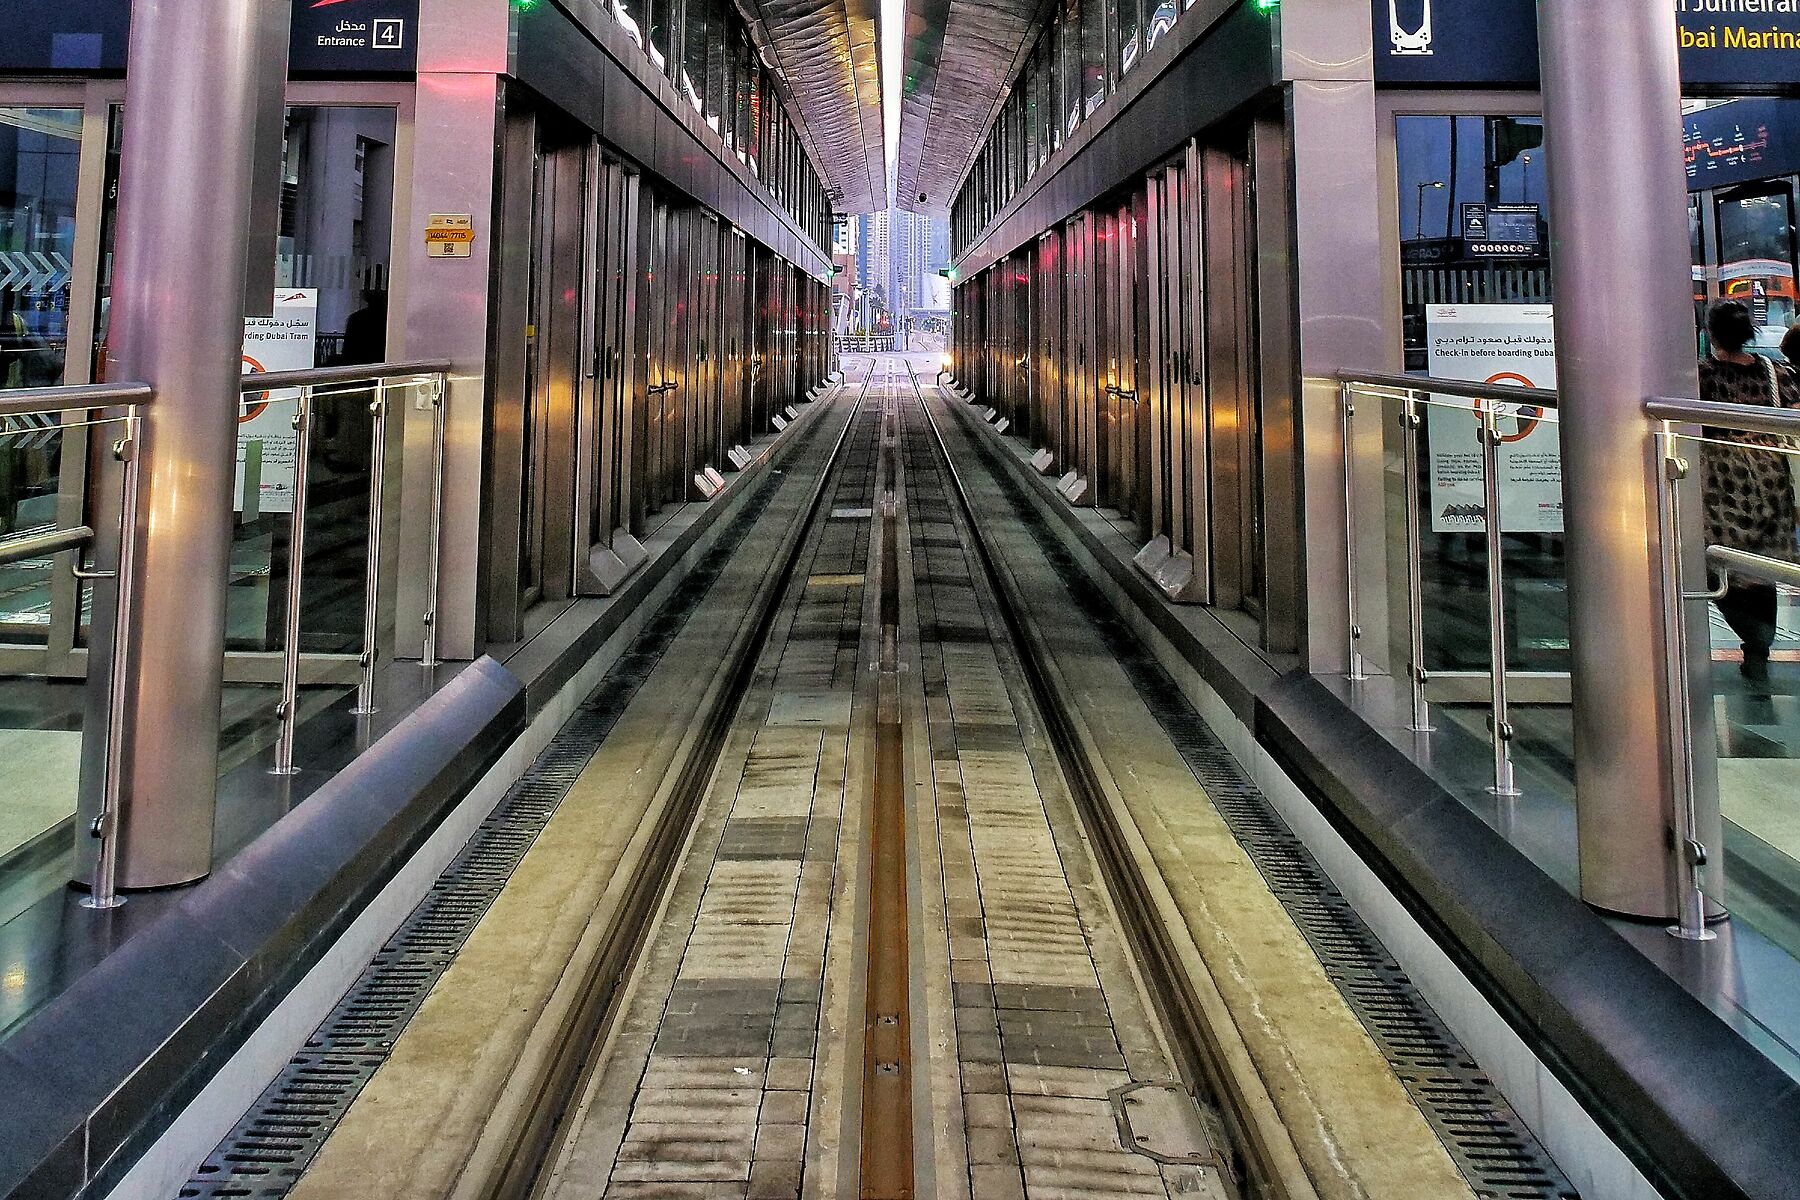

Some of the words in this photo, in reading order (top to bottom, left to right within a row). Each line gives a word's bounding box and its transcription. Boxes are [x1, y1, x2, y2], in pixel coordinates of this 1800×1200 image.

[335, 20, 366, 33] مدخل
[380, 25, 395, 43] 4
[1680, 25, 1716, 48] bai
[317, 36, 366, 46] Entrance
[245, 332, 264, 341] rding
[266, 332, 288, 340] Dubai
[290, 332, 309, 340] Tram
[1470, 348, 1496, 357] before
[1497, 348, 1532, 358] boarding
[1534, 349, 1554, 357] Duba
